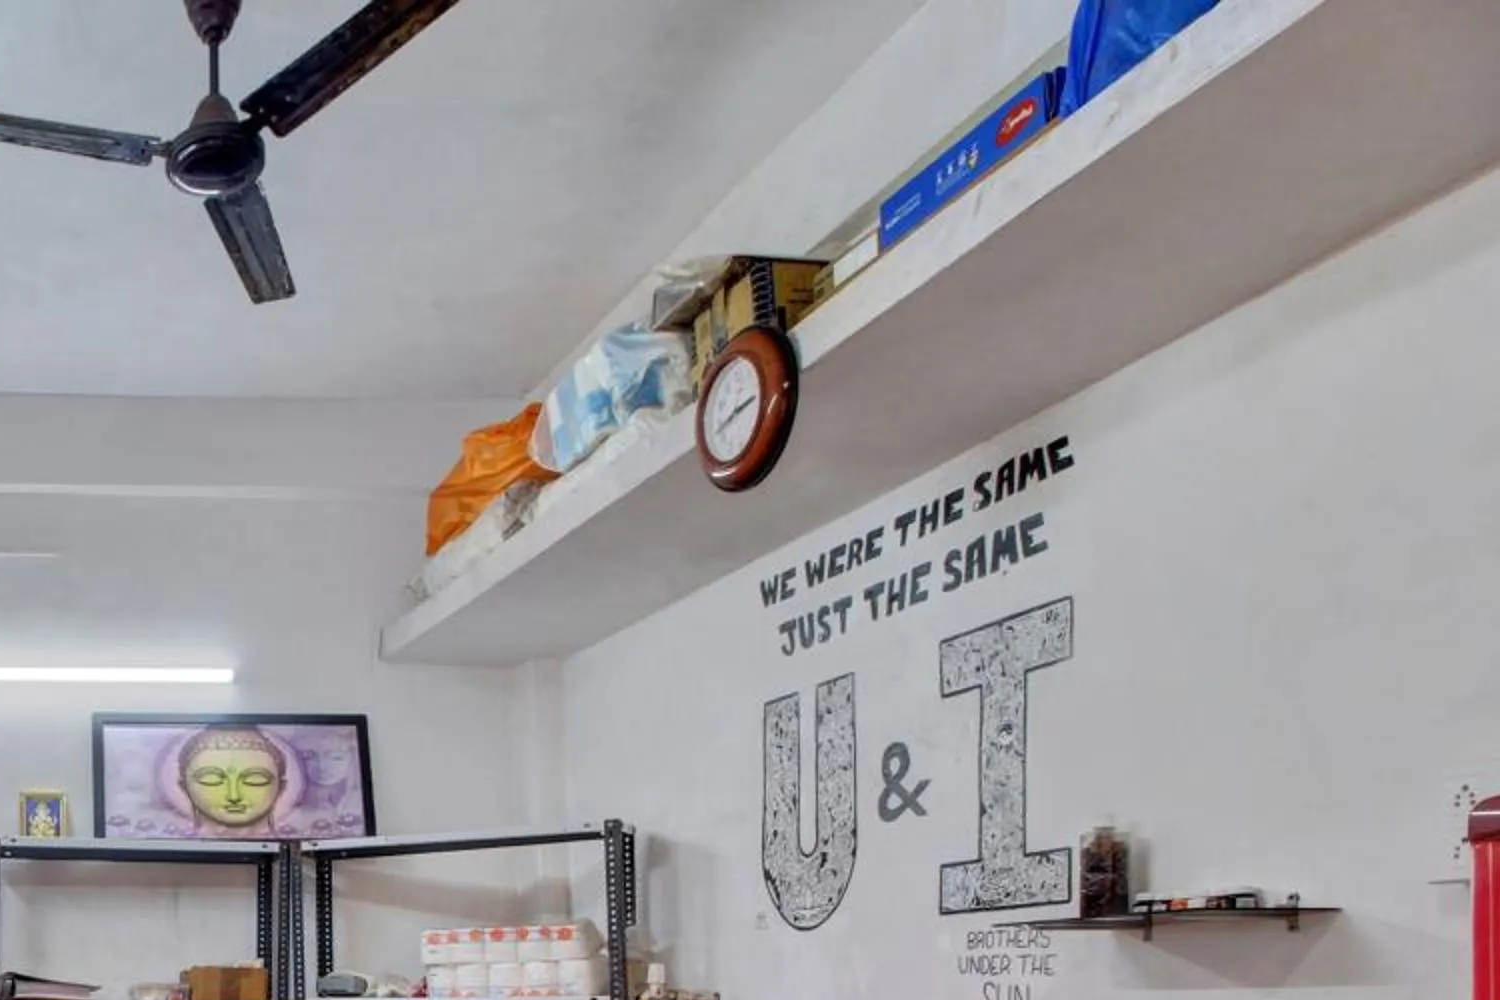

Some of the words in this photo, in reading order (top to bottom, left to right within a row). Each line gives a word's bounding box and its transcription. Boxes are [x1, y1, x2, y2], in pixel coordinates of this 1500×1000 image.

[759, 567, 797, 608] WE
[804, 527, 883, 587] WERE
[893, 486, 965, 549] THE
[972, 435, 1076, 512] SAME
[778, 597, 852, 657] JUST
[862, 561, 932, 622] THE
[942, 512, 1049, 592] SAME
[762, 672, 857, 931] U
[877, 741, 932, 823] &
[938, 595, 1074, 916] I
[957, 953, 1012, 977] UNDER
[1016, 952, 1059, 977] THE
[966, 923, 1052, 950] BROTHERS
